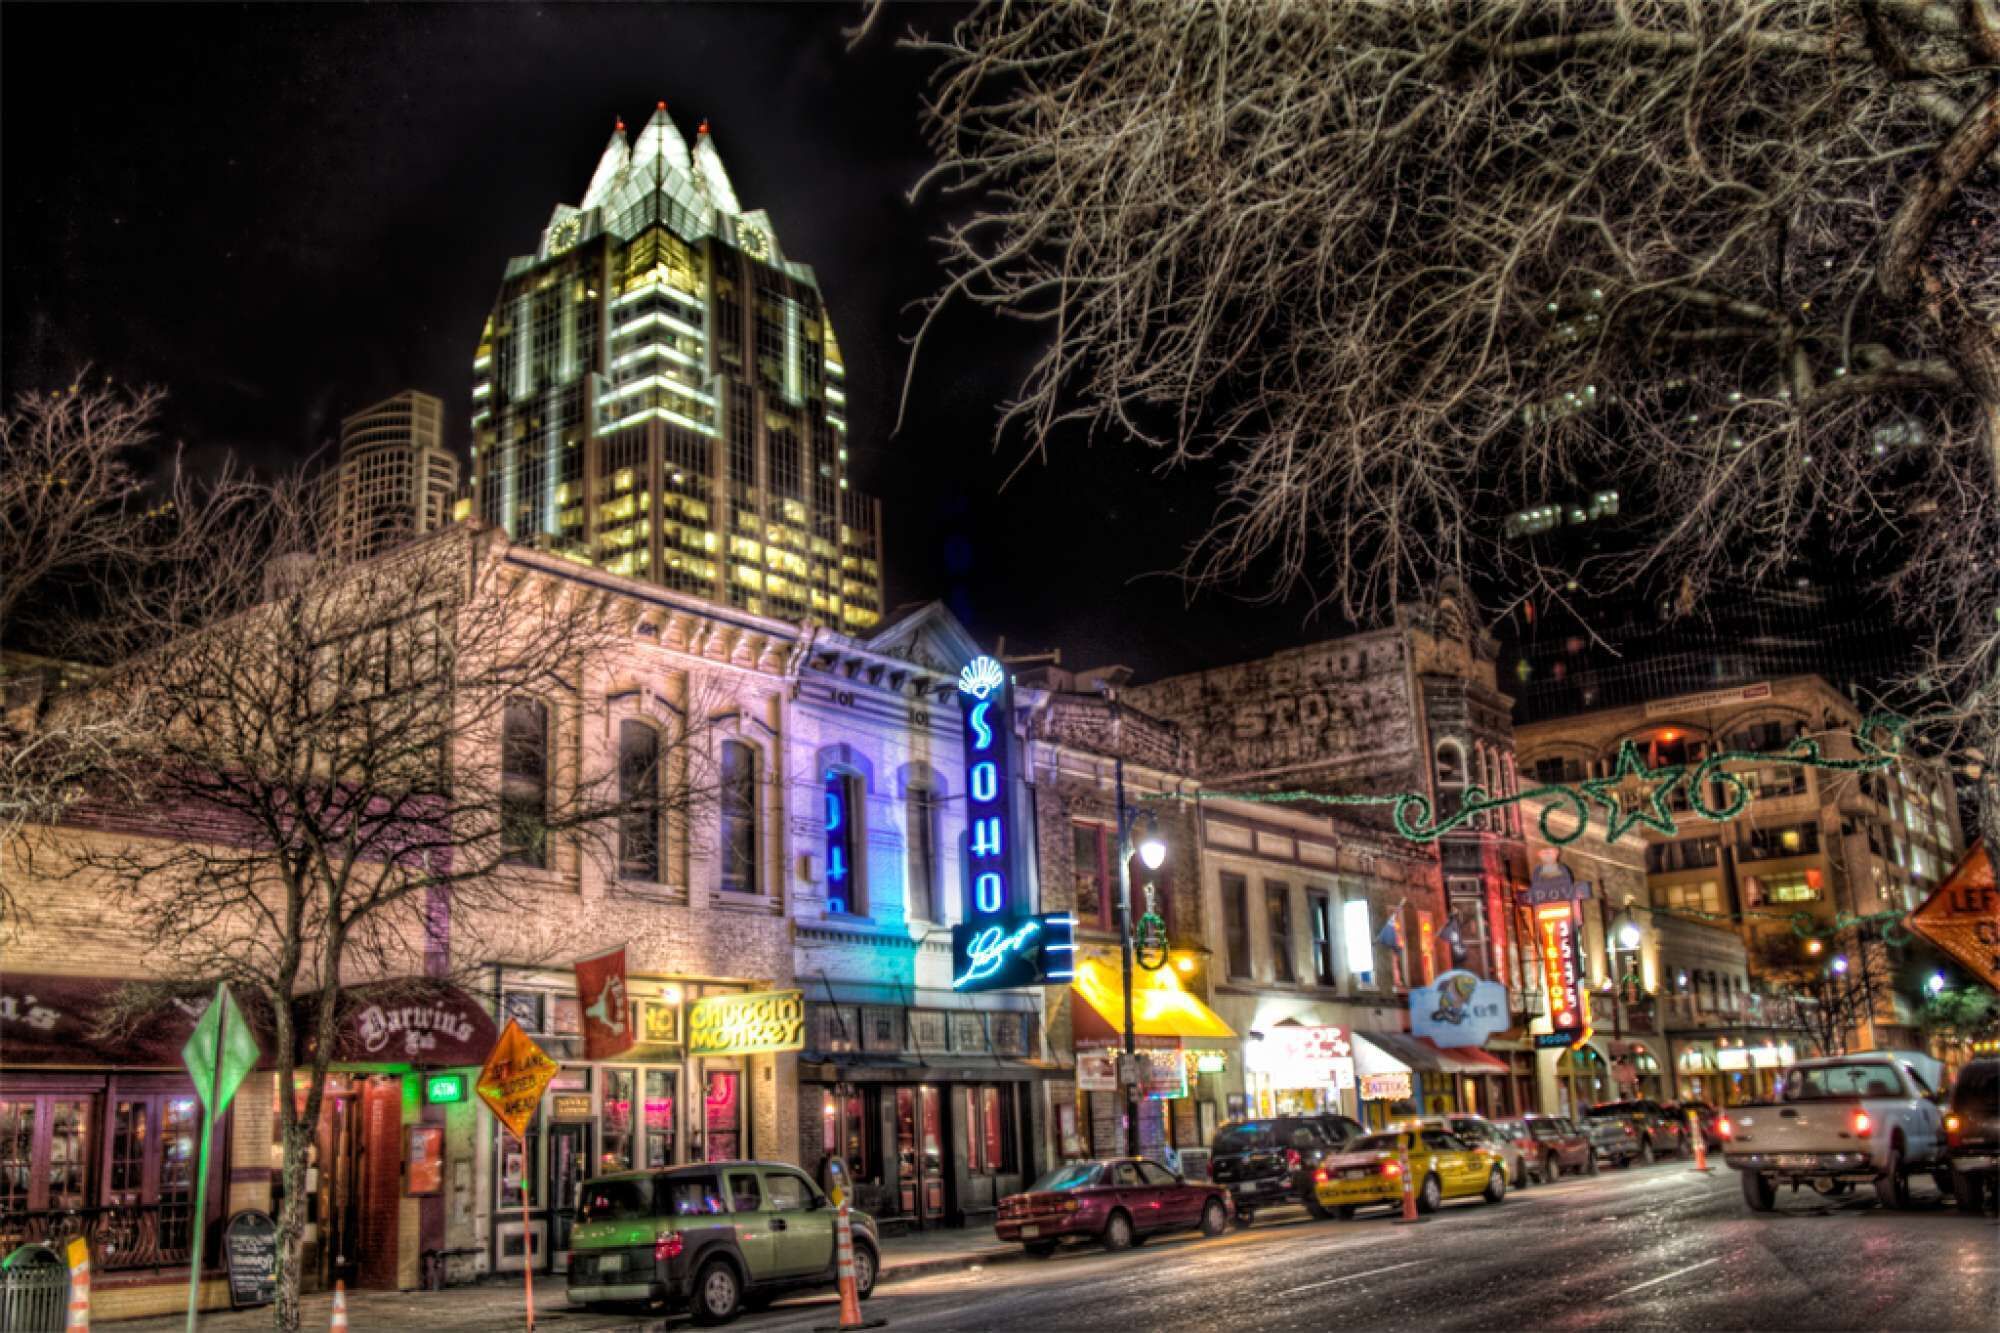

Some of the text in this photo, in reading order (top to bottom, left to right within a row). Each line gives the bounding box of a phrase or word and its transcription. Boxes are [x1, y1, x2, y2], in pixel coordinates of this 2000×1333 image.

[970, 701, 1002, 913] SOHO
[358, 1000, 475, 1053] Darwin's
[432, 1081, 456, 1096] ATM
